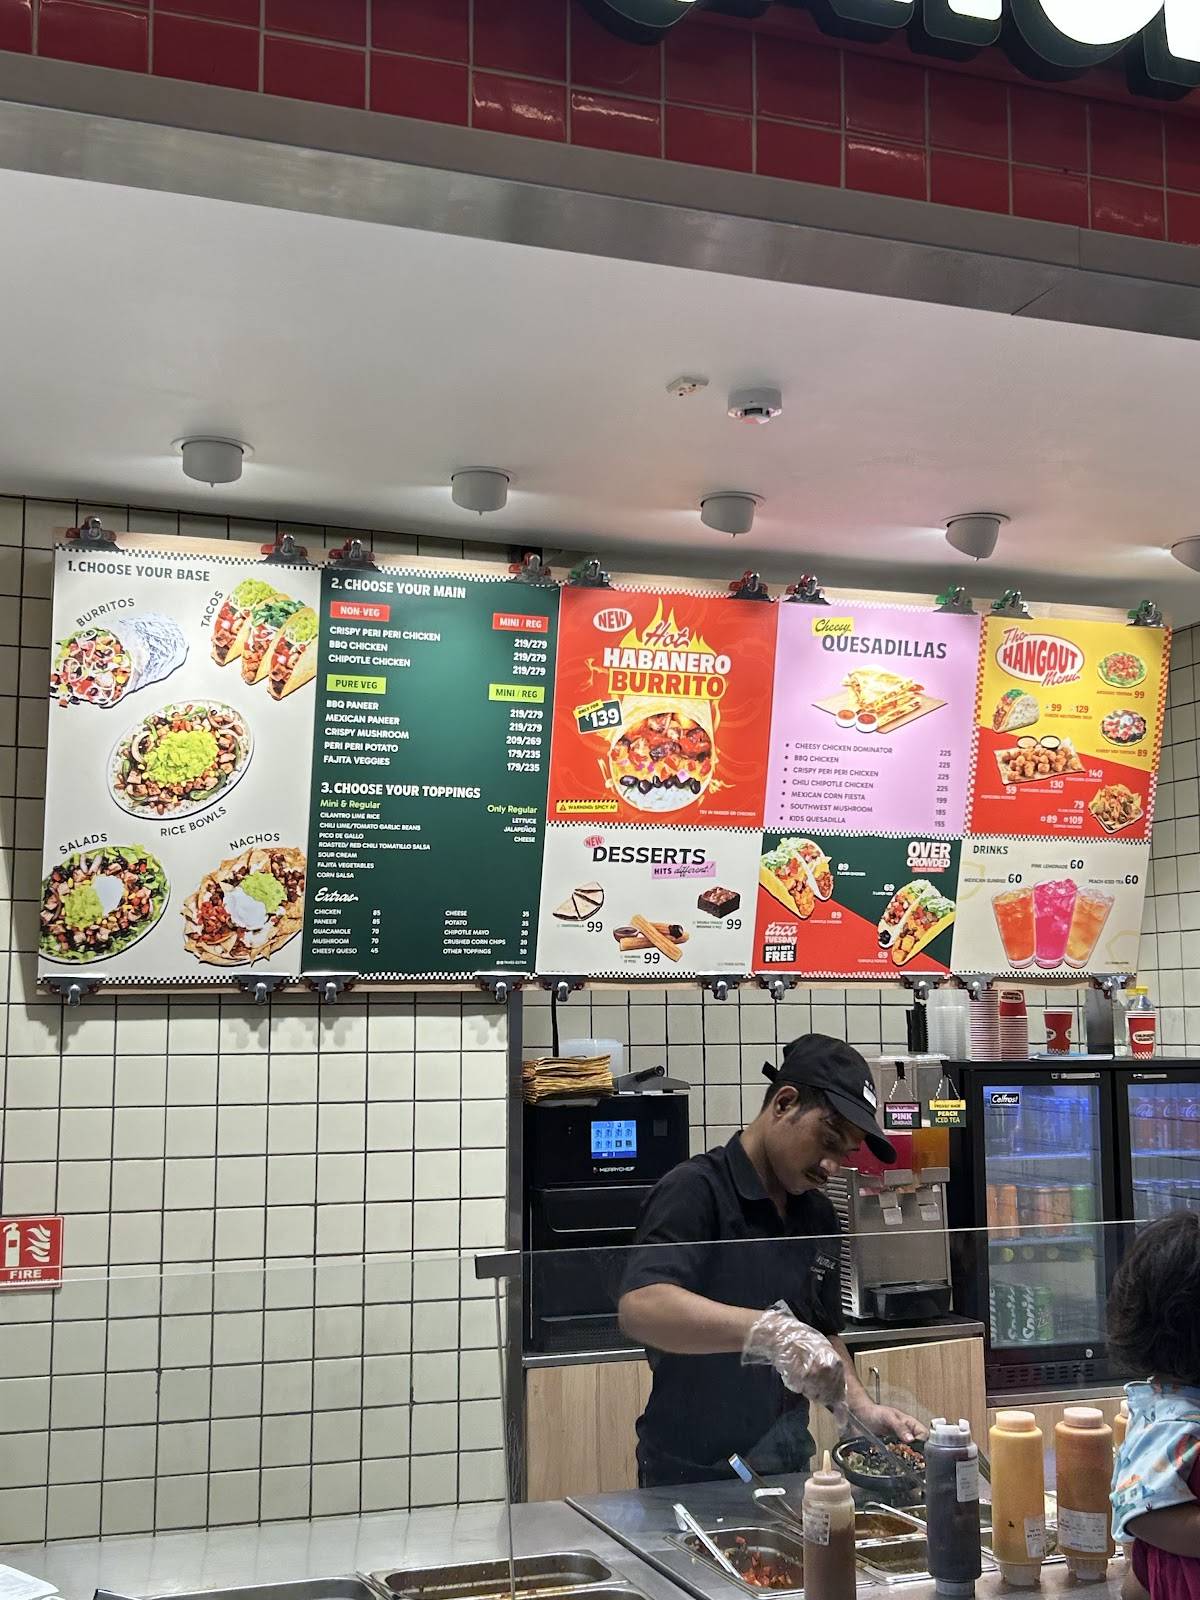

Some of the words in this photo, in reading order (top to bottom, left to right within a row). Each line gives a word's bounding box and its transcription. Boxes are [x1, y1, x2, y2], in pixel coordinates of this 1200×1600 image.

[68, 561, 76, 571] 1.
[79, 562, 131, 575] CHOOSE
[136, 564, 173, 578] YOUR
[177, 569, 210, 581] BASE
[331, 578, 342, 589] 2.
[345, 579, 393, 593] CHOOSE
[397, 583, 430, 596] YOUR
[434, 586, 466, 598] MAIN
[76, 598, 135, 627] BURRITOS
[201, 591, 223, 627] TACOS
[340, 606, 380, 617] NON-VEG
[500, 618, 519, 626] MINI
[526, 619, 542, 628] REG
[598, 612, 627, 629] NEW
[815, 620, 851, 636] Cheesy
[330, 626, 360, 636] CRISPY
[363, 628, 381, 637] PERI
[383, 629, 401, 638] PERI
[403, 630, 440, 642] CHICKEN
[644, 621, 691, 648] Hot
[1004, 629, 1027, 645] The
[329, 640, 348, 649] BBQ
[349, 642, 388, 652] CHICKEN
[514, 639, 547, 649] 219/279
[822, 635, 947, 659] QUESADILLAS
[328, 655, 370, 665] CHIPOTLE
[372, 657, 410, 667] CHICKEN
[514, 652, 546, 663] 219/279
[604, 648, 731, 674] HABANERO
[1003, 640, 1078, 676] HANGOUT
[513, 666, 546, 676] 219/279
[336, 680, 358, 688] PURE
[361, 681, 377, 689] VEG
[611, 671, 724, 697] BURRITO
[1041, 671, 1080, 687] Menu
[496, 688, 514, 697] MINI
[522, 690, 537, 698] REG
[326, 700, 344, 709] BBQ
[346, 701, 379, 710] PANEER
[1076, 705, 1089, 713] 129
[326, 714, 365, 724] MEXICAN
[368, 716, 400, 725] PANEER
[325, 728, 355, 737] CRISPY
[357, 729, 409, 739] MUSHROOM
[324, 742, 343, 750] PERI
[345, 742, 363, 751] PERI
[365, 744, 398, 752] POTATO
[853, 745, 892, 753] DOMINATOR
[508, 749, 540, 759] 179/235
[324, 756, 352, 765] FAJITA
[354, 756, 390, 766] VEGGIES
[507, 762, 540, 772] 179/235
[1089, 770, 1102, 778] 140
[321, 782, 332, 794] 3.
[334, 784, 382, 795] CHOOSE
[386, 785, 419, 796] YOUR
[422, 786, 481, 798] TOPPINGS
[1006, 786, 1017, 794] 59
[320, 800, 339, 809] Mini
[341, 800, 347, 808] &
[349, 801, 380, 810] Regular
[487, 805, 506, 814] Only
[508, 806, 537, 814] Regular
[320, 812, 350, 820] CILANTRO
[160, 825, 186, 837] RICE
[189, 807, 227, 831] BOWLS
[59, 833, 108, 854] SALADS
[229, 833, 280, 851] NACHOS
[585, 837, 603, 846] NEW
[908, 842, 951, 858] OVER
[973, 845, 1008, 854] DRINKS
[593, 846, 706, 865] DESSERTS
[907, 858, 950, 868] CROWDED
[1070, 860, 1084, 869] 60
[1008, 874, 1022, 883] 60
[1125, 875, 1139, 884] 60
[315, 887, 359, 903] Extras
[587, 922, 603, 932] 99
[726, 919, 742, 930] 99
[765, 936, 797, 945] TUESDAY
[644, 953, 660, 964] 99
[765, 951, 794, 962] FREE
[991, 1094, 1018, 1104] Celfrost
[10, 1270, 42, 1279] FIRE
